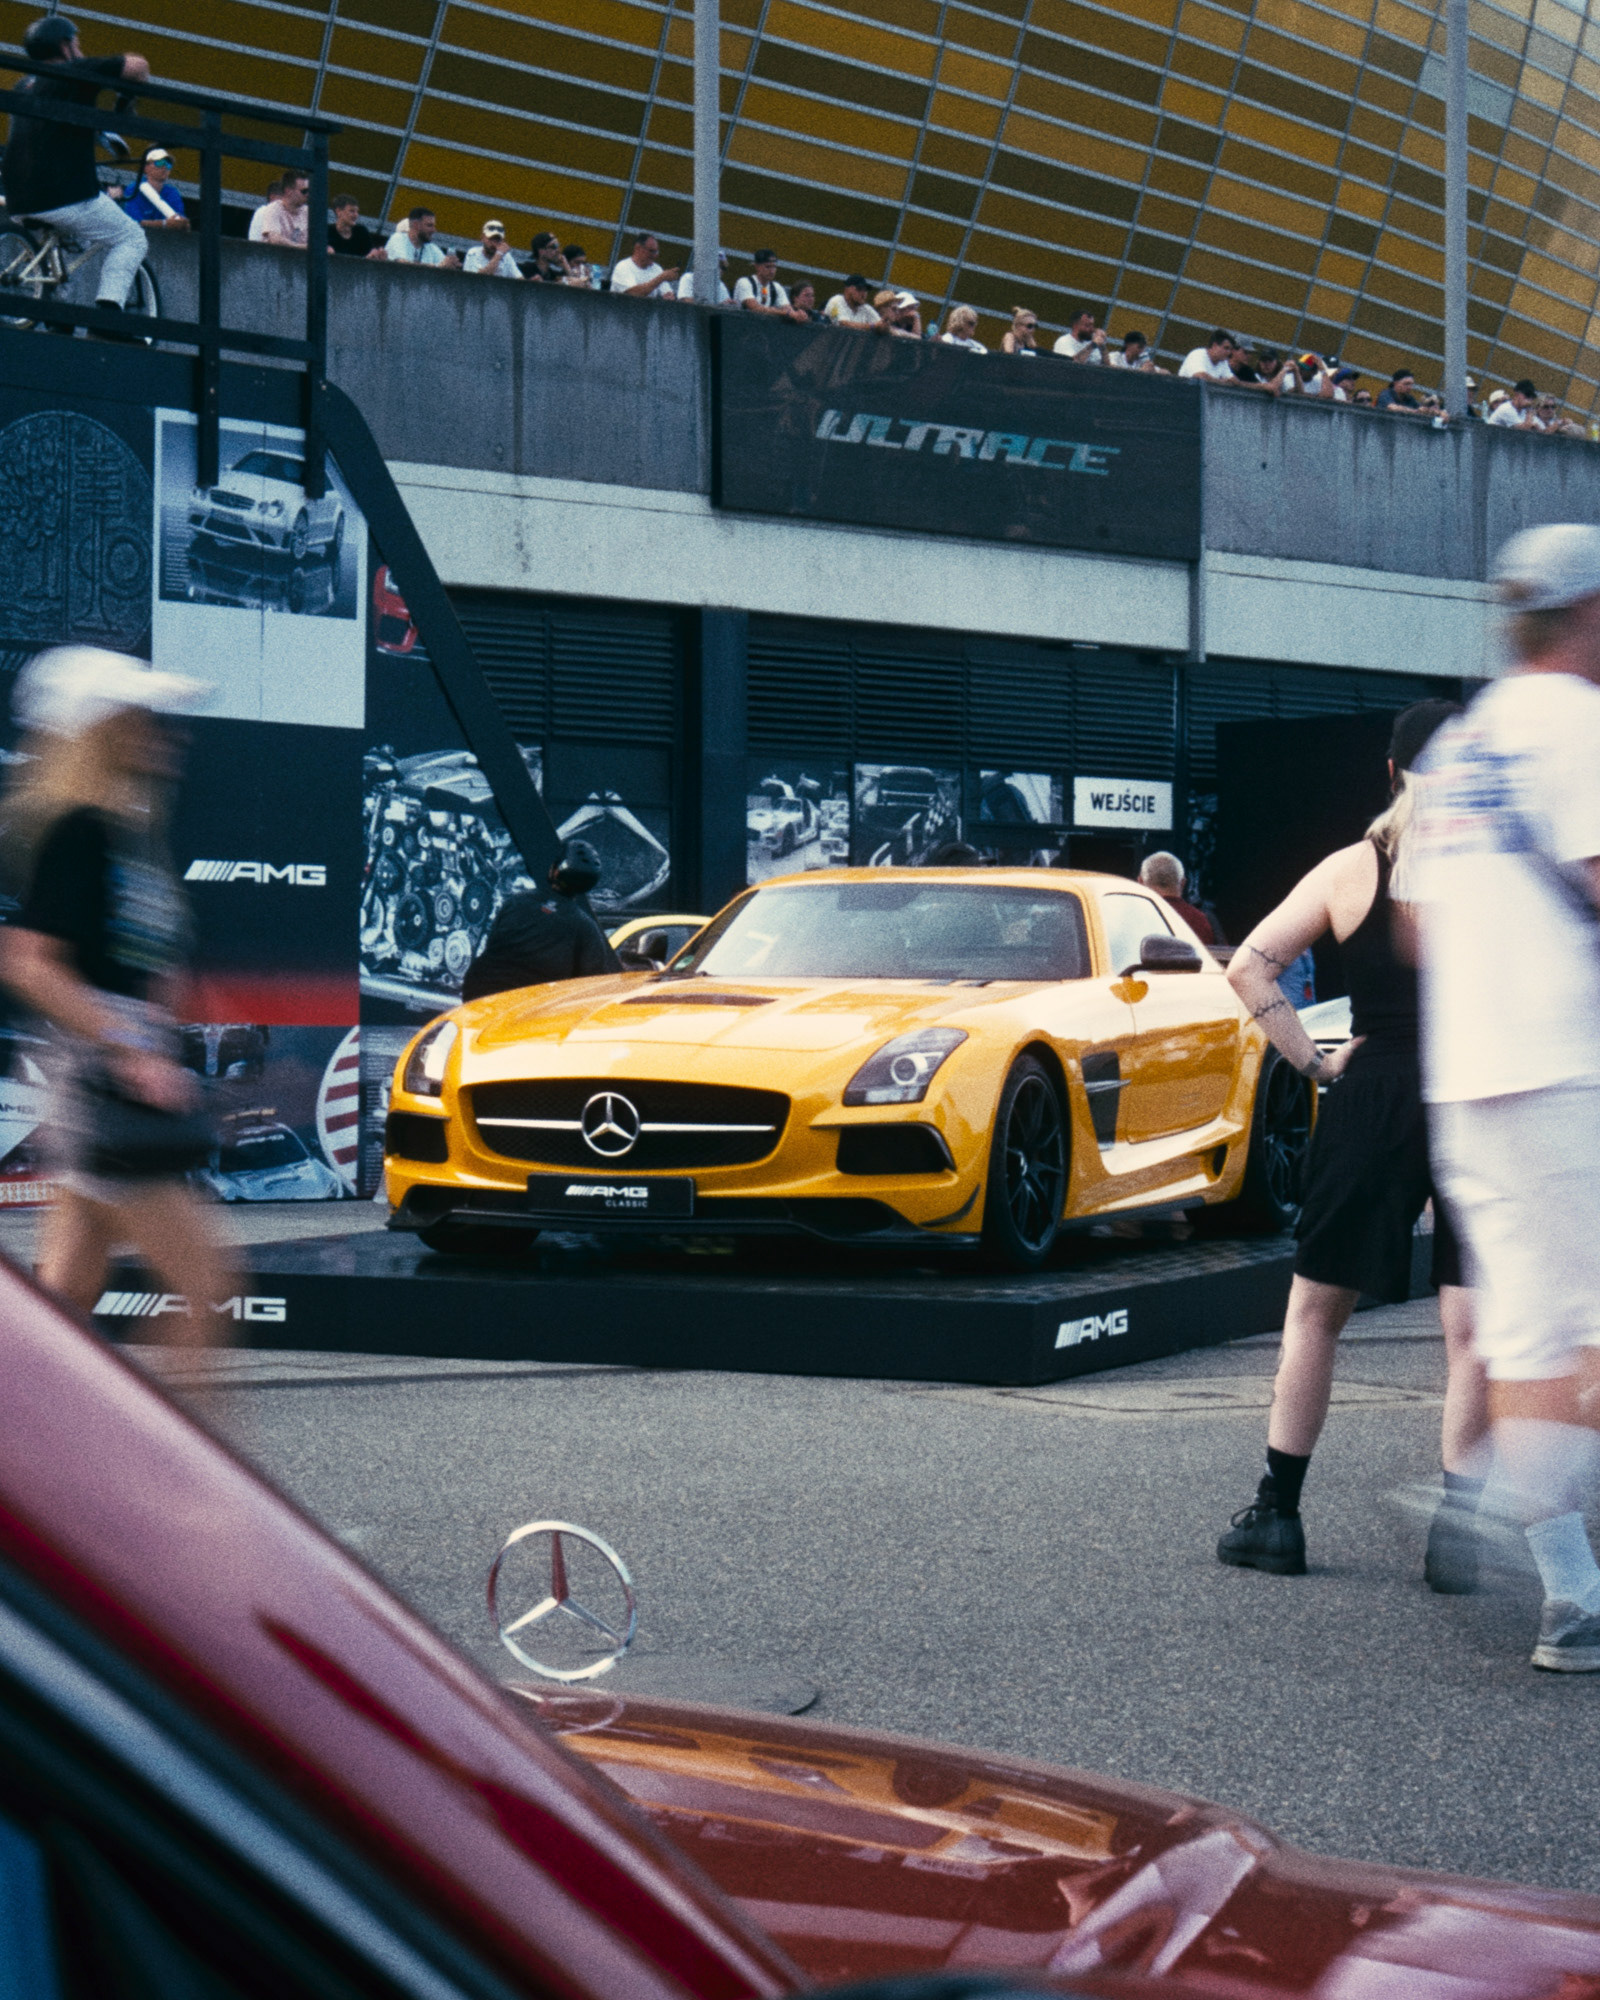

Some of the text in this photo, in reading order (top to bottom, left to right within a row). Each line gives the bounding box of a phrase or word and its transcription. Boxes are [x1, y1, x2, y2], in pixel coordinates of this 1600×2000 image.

[815, 409, 1121, 475] ULTRACE
[1090, 788, 1156, 813] WEJŚCIE
[227, 861, 327, 886] AMG
[591, 1185, 648, 1198] AMG
[605, 1199, 648, 1208] CLASSIC
[1079, 1309, 1128, 1343] AMG
